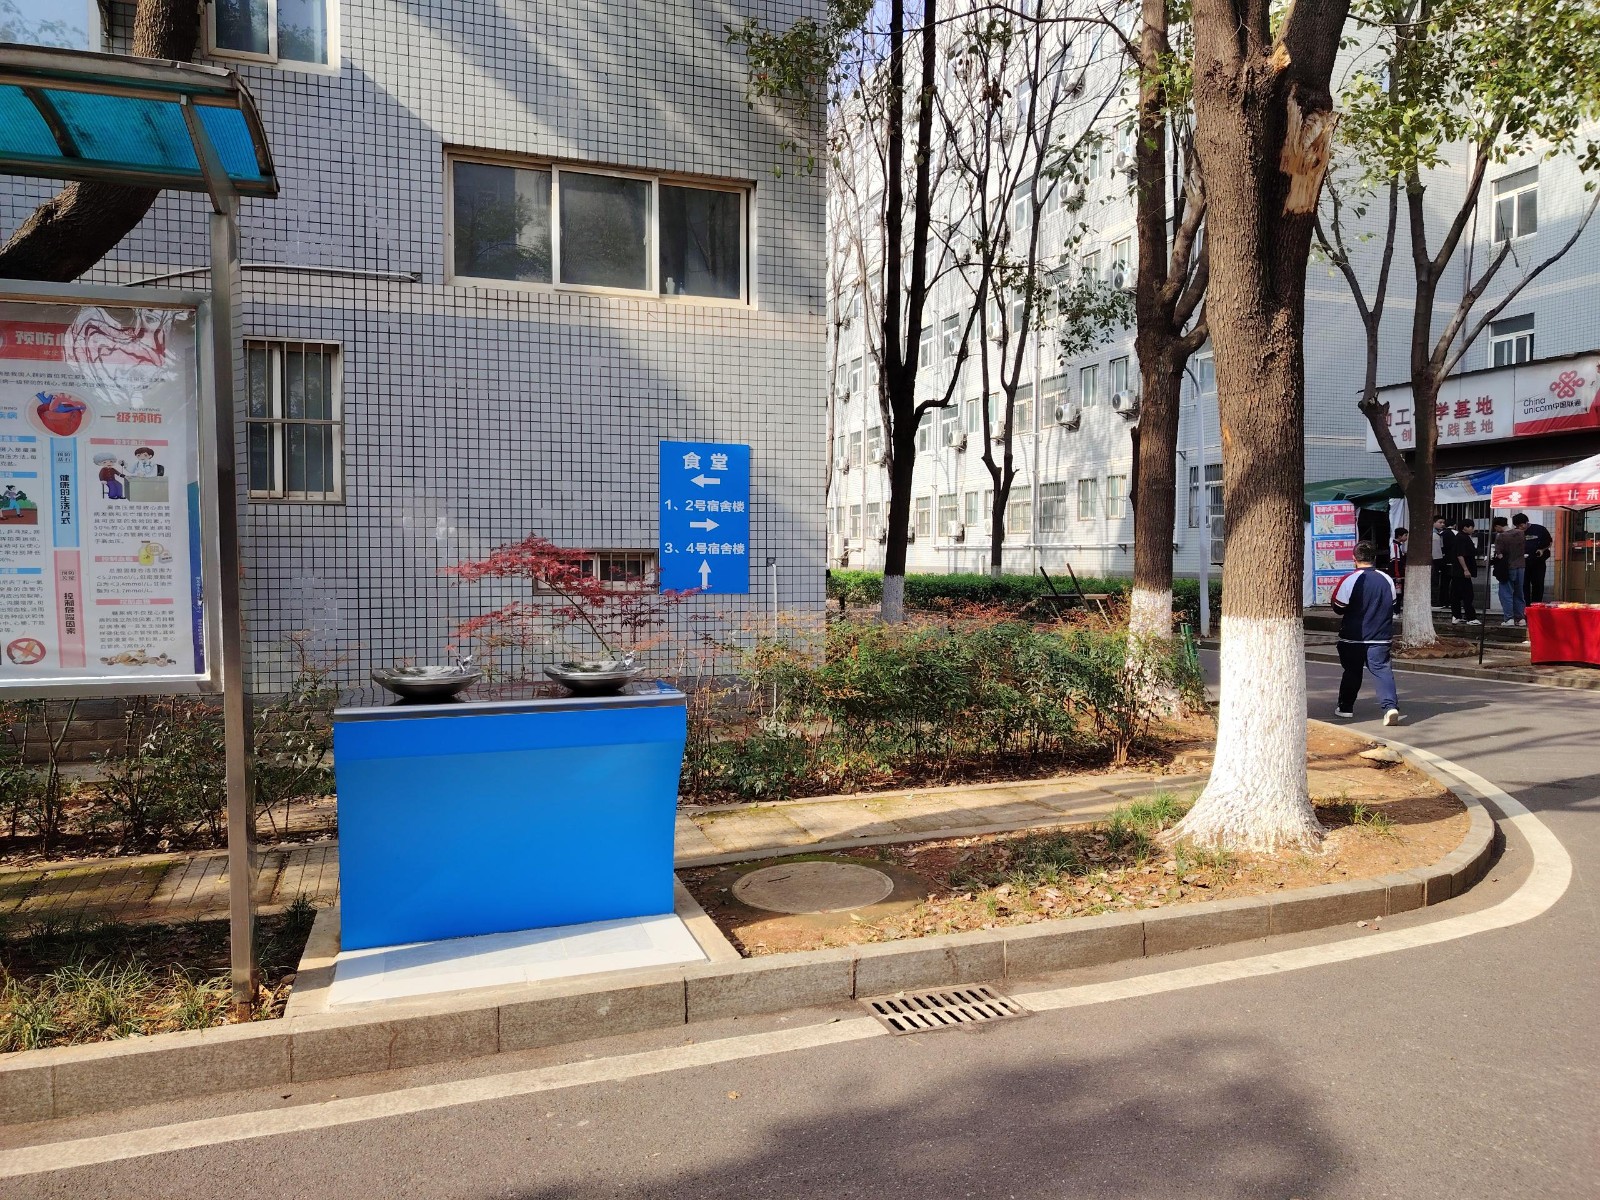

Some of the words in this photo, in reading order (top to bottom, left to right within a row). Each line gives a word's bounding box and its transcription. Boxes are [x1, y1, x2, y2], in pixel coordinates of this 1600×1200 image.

[1523, 397, 1546, 407] China
[1523, 404, 1553, 414] unicom
[101, 411, 162, 423] 一级预防
[683, 452, 728, 470] 食堂
[59, 474, 70, 525] 健康的生活方式
[664, 499, 745, 513] 1、2号宿舍楼
[664, 542, 745, 555] 3、4号宿舍楼
